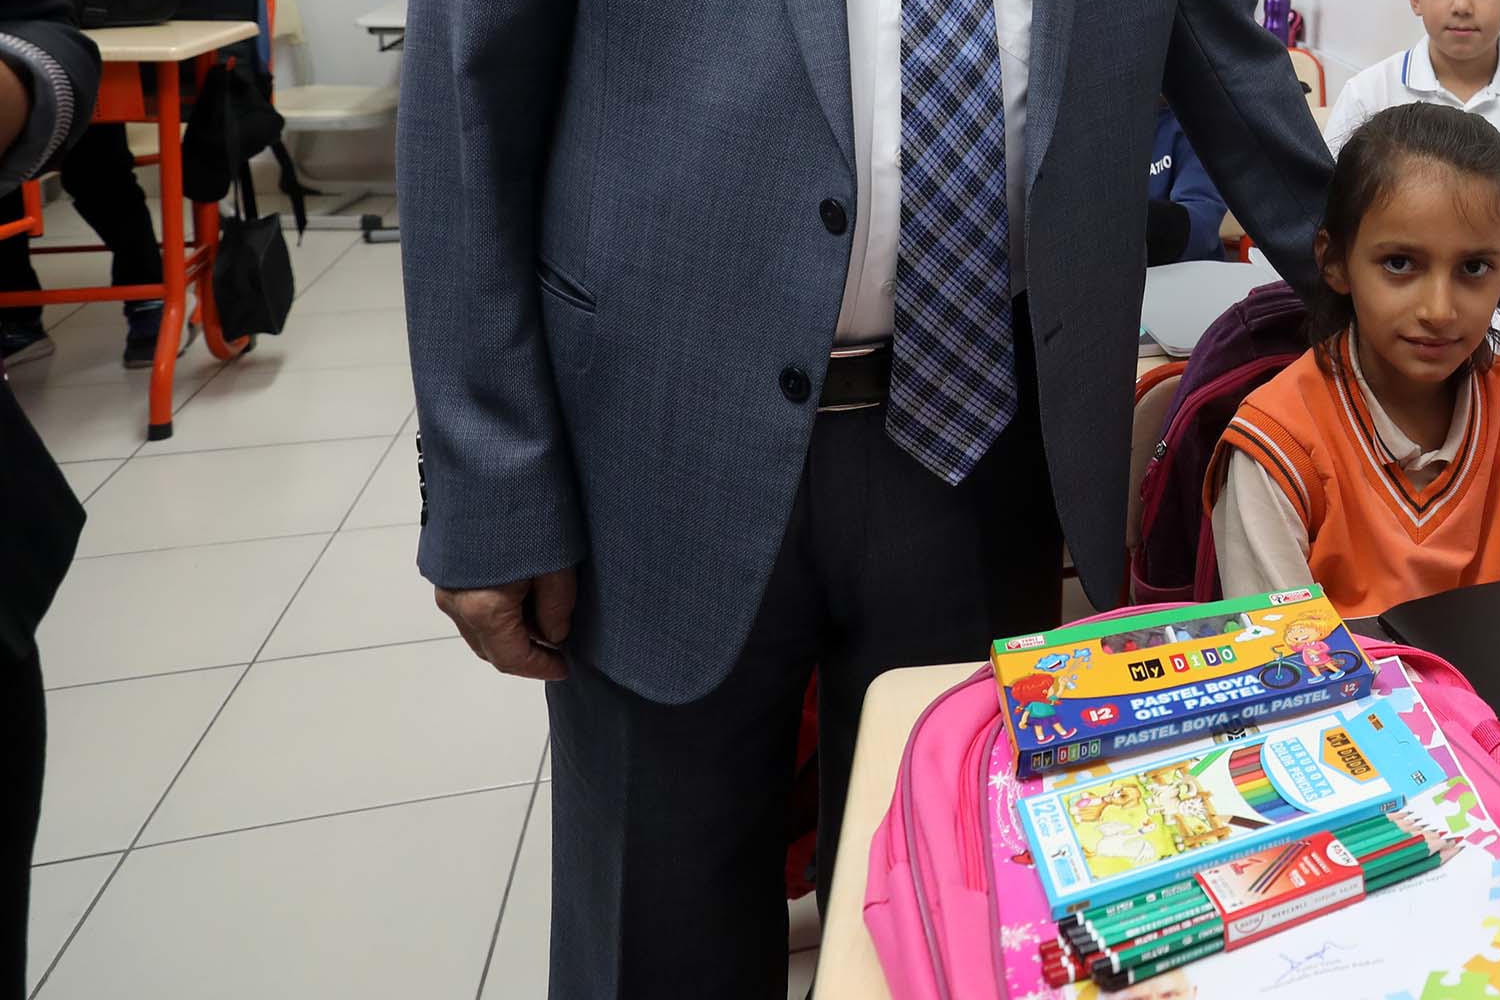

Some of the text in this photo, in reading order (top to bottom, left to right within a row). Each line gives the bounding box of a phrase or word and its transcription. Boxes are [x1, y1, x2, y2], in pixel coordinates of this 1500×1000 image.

[1130, 672, 1262, 710] PASTEL BOYA
[1134, 684, 1266, 721] OIL PASTEL
[1088, 707, 1114, 723] 12
[1113, 687, 1331, 748] PASTEL BOYA OIL PASTEL
[1289, 766, 1318, 802] PENCILS
